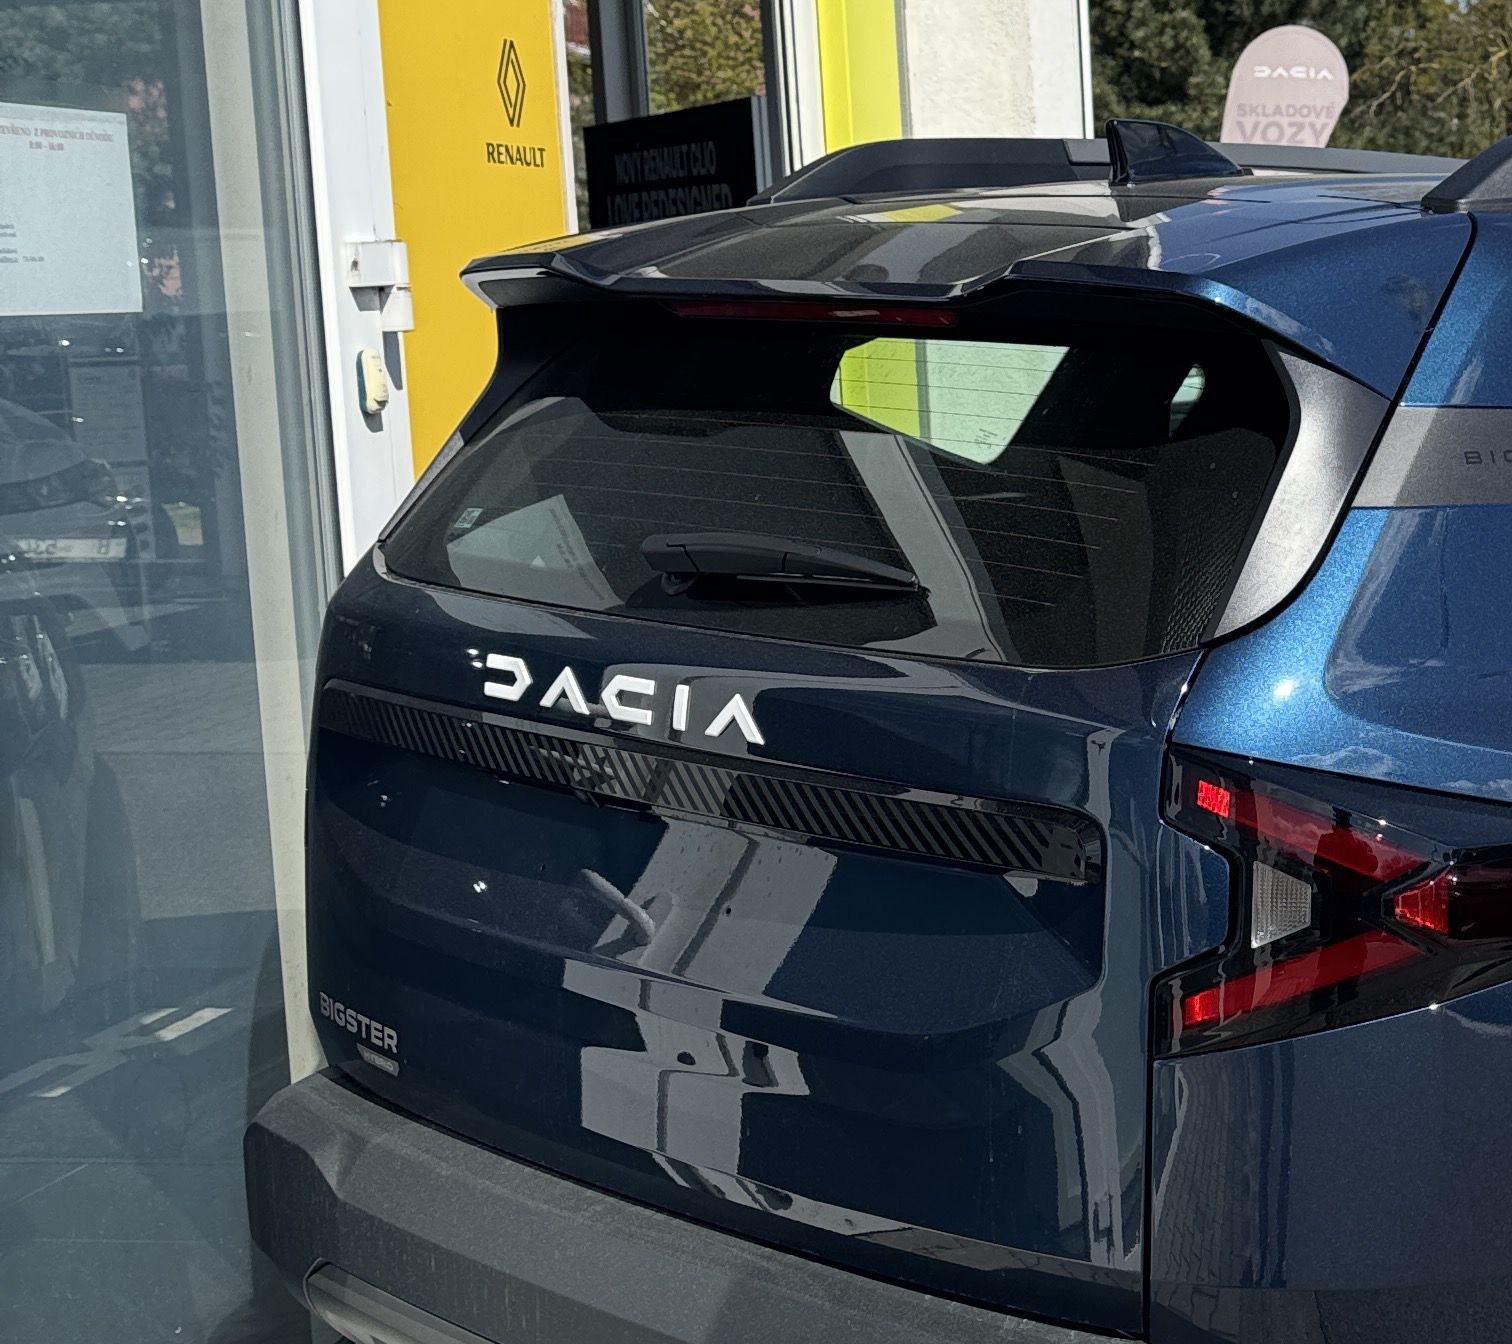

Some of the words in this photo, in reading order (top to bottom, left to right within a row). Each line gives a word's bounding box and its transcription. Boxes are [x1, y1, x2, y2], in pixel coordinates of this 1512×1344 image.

[1253, 65, 1334, 81] DACIA
[1236, 102, 1337, 120] SKLADOVÉ
[1235, 120, 1329, 146] VOZY
[486, 142, 546, 168] RENAULT
[644, 144, 688, 182] RENAULT
[690, 140, 717, 177] CLIO
[483, 652, 766, 746] DACIA
[319, 991, 399, 1054] BIGSTER
